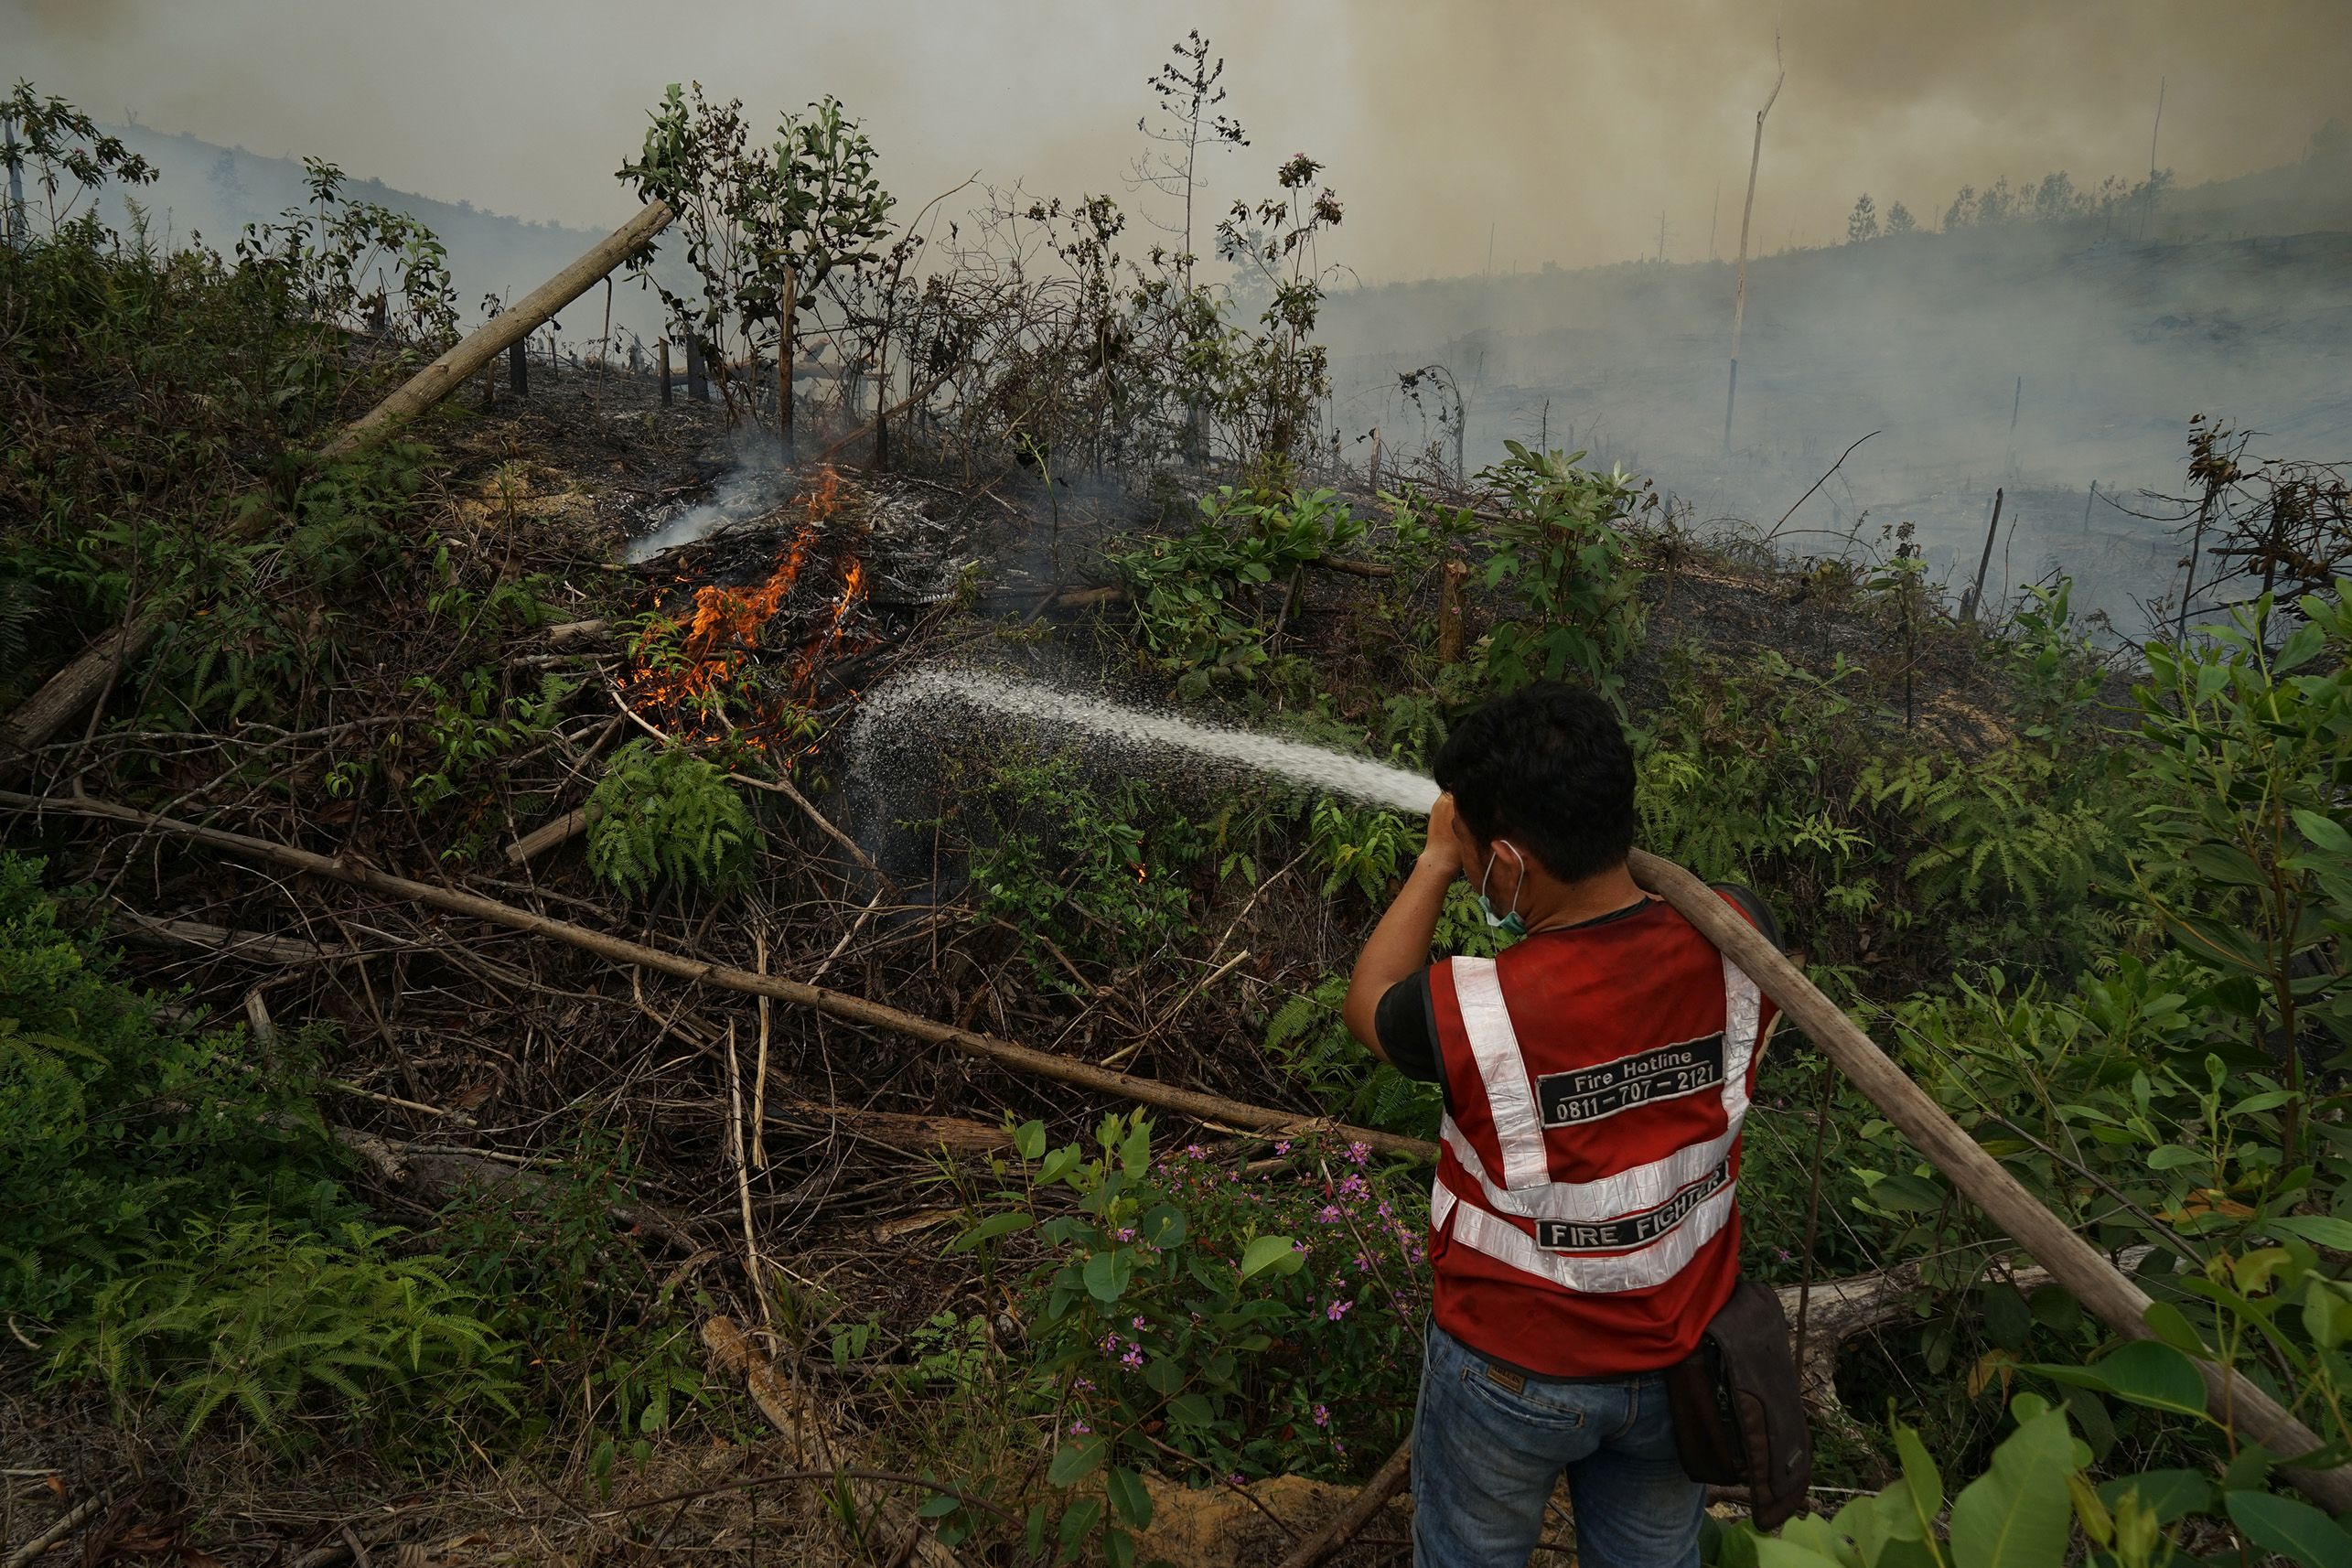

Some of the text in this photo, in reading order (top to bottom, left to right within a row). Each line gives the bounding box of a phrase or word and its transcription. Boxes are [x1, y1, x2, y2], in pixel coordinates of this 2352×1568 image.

[1574, 1050, 1692, 1093] Fire Hotline
[1551, 1170, 1721, 1246] FIRE FIGHTER
